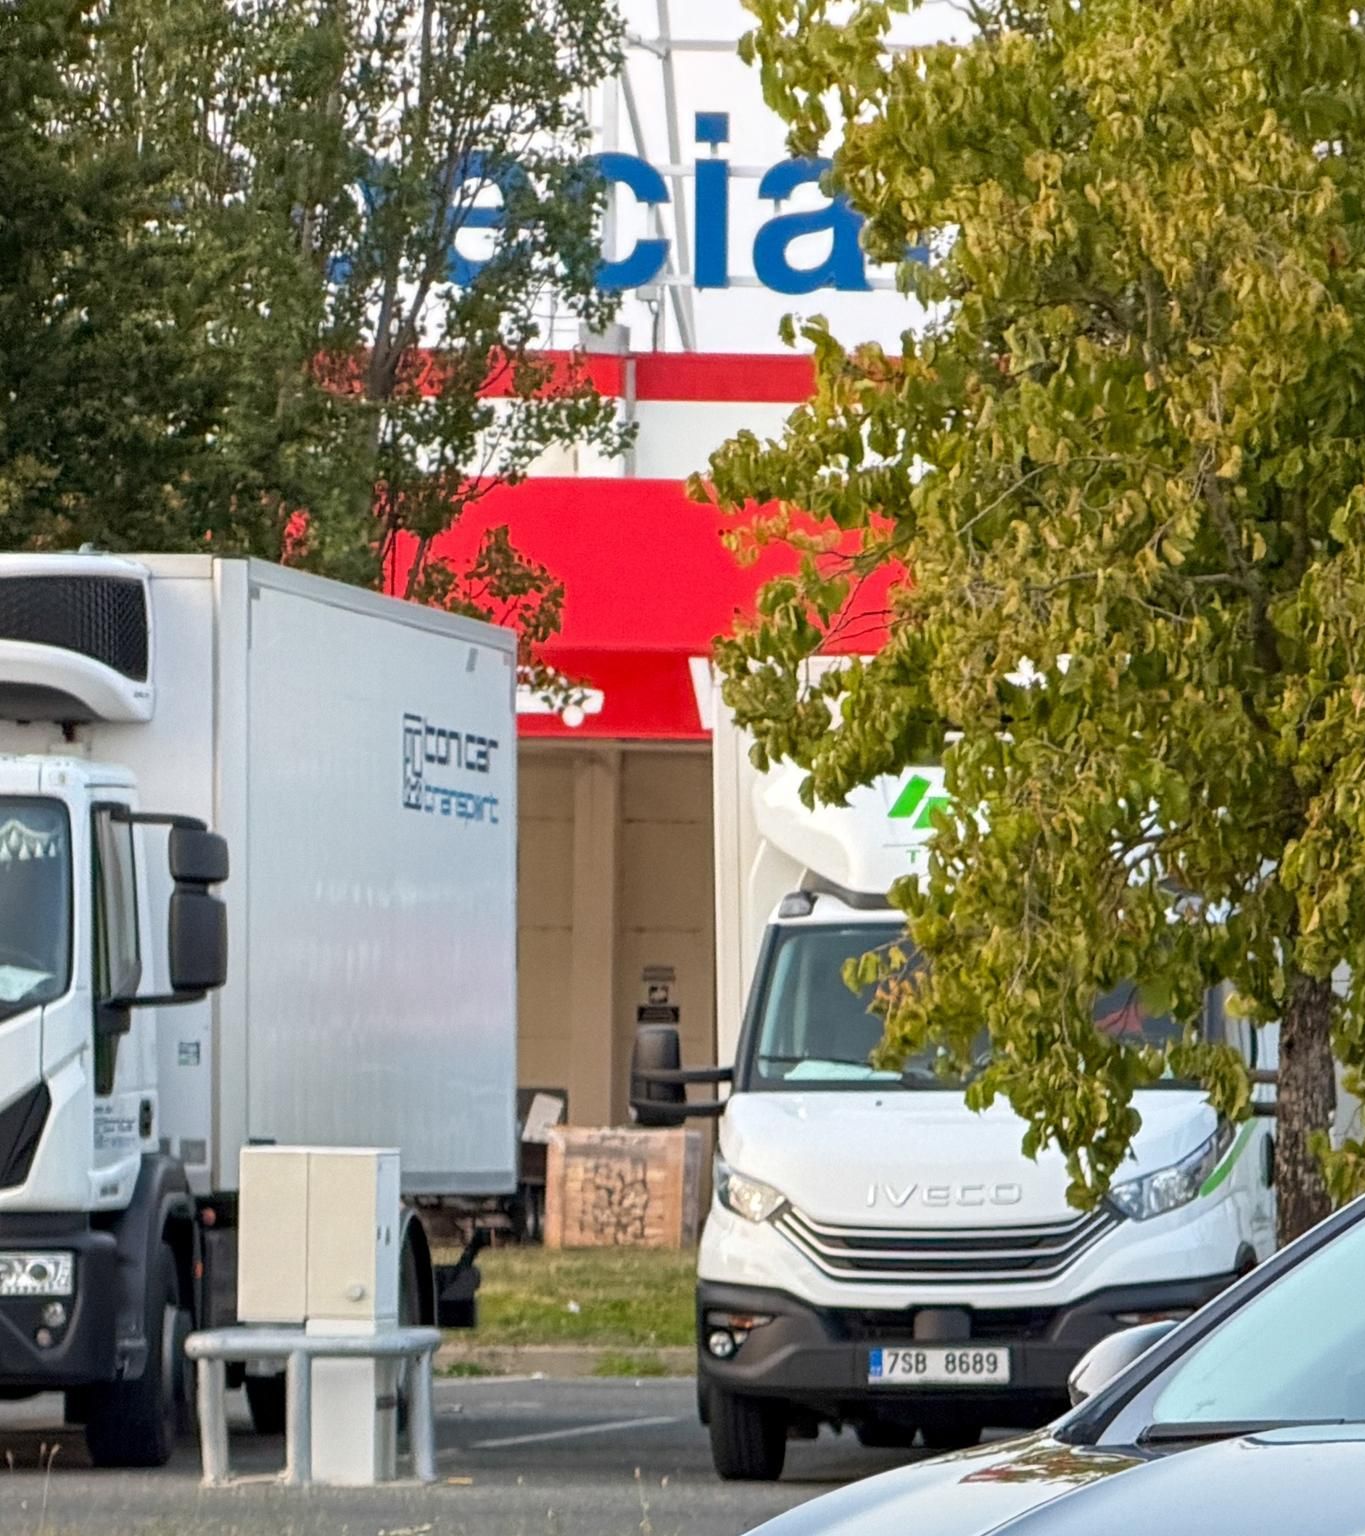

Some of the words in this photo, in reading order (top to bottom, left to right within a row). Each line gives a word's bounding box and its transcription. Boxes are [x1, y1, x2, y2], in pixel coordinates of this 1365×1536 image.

[865, 1183, 1023, 1208] IVECO
[887, 1352, 928, 1375] 7SB
[944, 1352, 998, 1375] 8689
